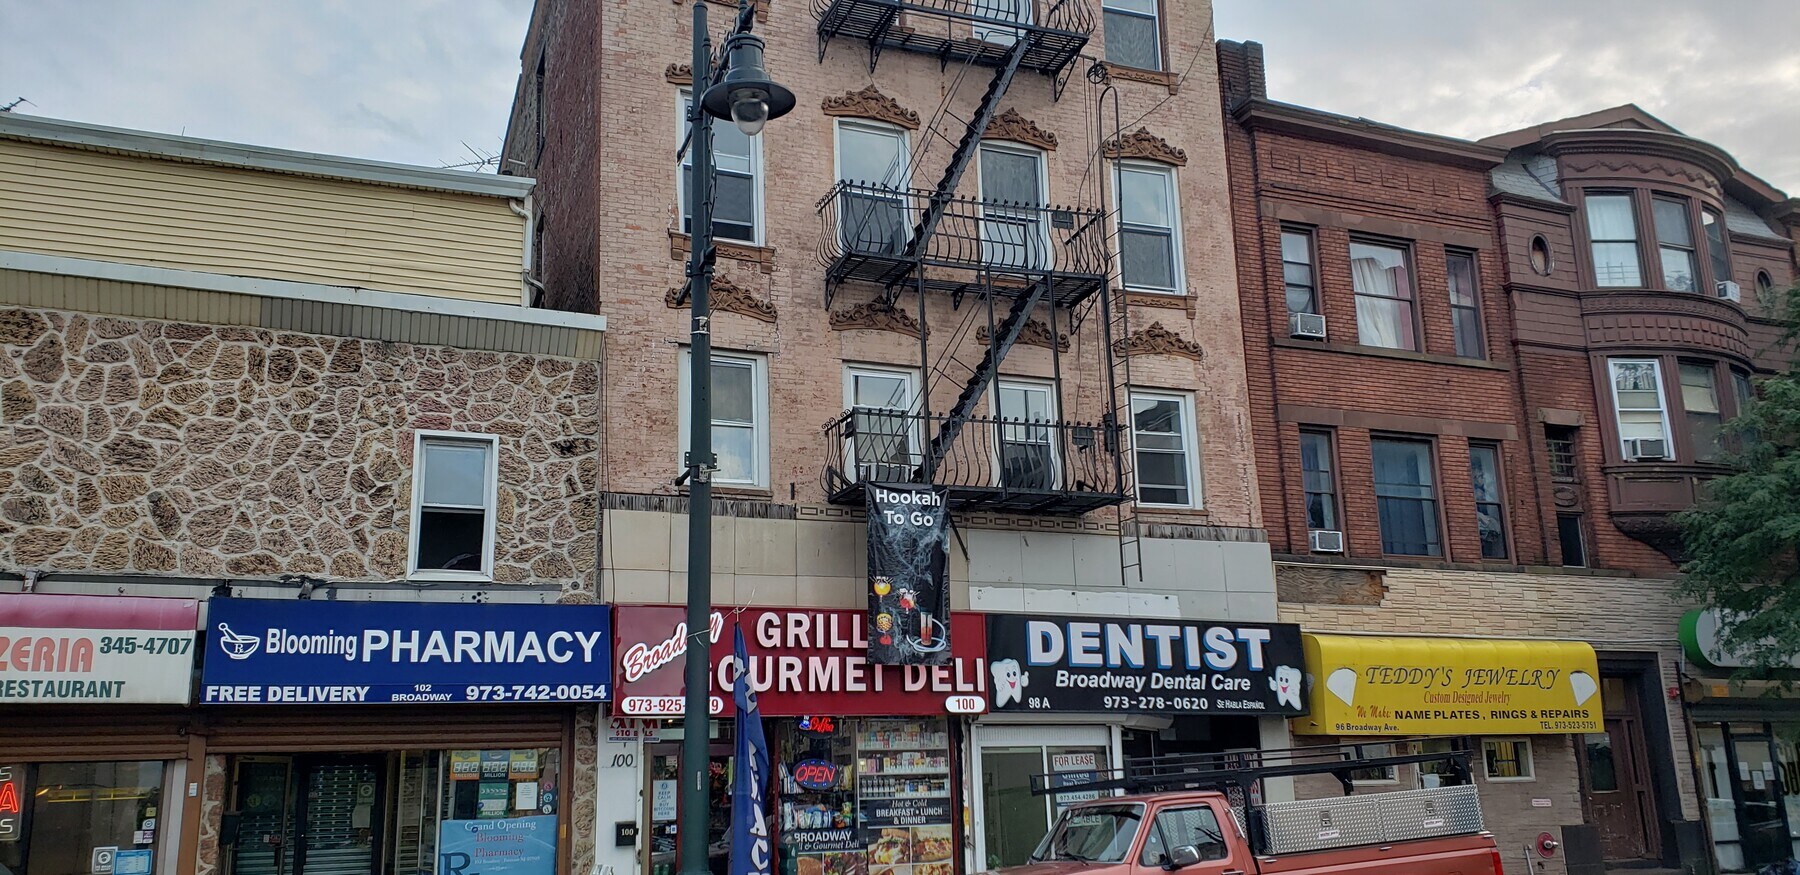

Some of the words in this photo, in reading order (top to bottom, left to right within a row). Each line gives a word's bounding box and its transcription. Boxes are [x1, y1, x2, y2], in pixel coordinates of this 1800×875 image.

[876, 489, 941, 507] Hookah
[884, 510, 905, 525] To
[910, 512, 934, 526] Go
[100, 636, 192, 655] 345-4707
[266, 628, 357, 661] Blooming
[363, 630, 601, 663] PHARMACY
[623, 612, 724, 682] Broady
[1026, 620, 1271, 671] DENTIST
[709, 655, 886, 692] OURMET
[904, 656, 984, 693] DELI
[1365, 666, 1453, 687] TEDDY'S
[1461, 669, 1560, 689] JEWELRY
[1055, 670, 1146, 692] Broadway
[1150, 671, 1206, 690] Dental
[1211, 674, 1251, 691] Care
[206, 686, 261, 702] FREE
[267, 686, 370, 702] DELIVERY
[414, 684, 432, 692] 102
[466, 685, 606, 700] 973-742-0054
[955, 698, 975, 710] 100
[1028, 697, 1042, 708] 98
[1043, 698, 1050, 708] A
[1103, 697, 1208, 710] 973-278-0620
[1423, 691, 1451, 704] Custom
[1452, 692, 1483, 706] Designed
[1483, 692, 1512, 706] Jewelry
[628, 699, 719, 712] 973-925-9
[1357, 705, 1368, 719] We
[1394, 710, 1432, 720] NAME
[1491, 710, 1527, 719] RINGS
[1531, 710, 1538, 719] &
[1541, 709, 1589, 719] REPAIRS
[1336, 723, 1345, 731] 96
[1347, 723, 1382, 733] Broadway
[1384, 724, 1400, 732] Ave.
[1540, 721, 1554, 730] TEL.
[1554, 721, 1597, 730] 973-523-5751
[611, 754, 634, 767] 100
[1054, 757, 1069, 767] FOR
[796, 766, 836, 782] OPEN
[876, 808, 914, 817] BREAKFAST
[920, 807, 943, 815] LUNCH
[464, 821, 494, 831] Gand
[497, 820, 537, 831] Opening
[900, 816, 926, 824] DINNER
[794, 831, 852, 843] BROADWAY
[812, 842, 843, 850] Gourmet
[845, 840, 860, 849] Deli
[474, 848, 524, 858] Pharmacy
